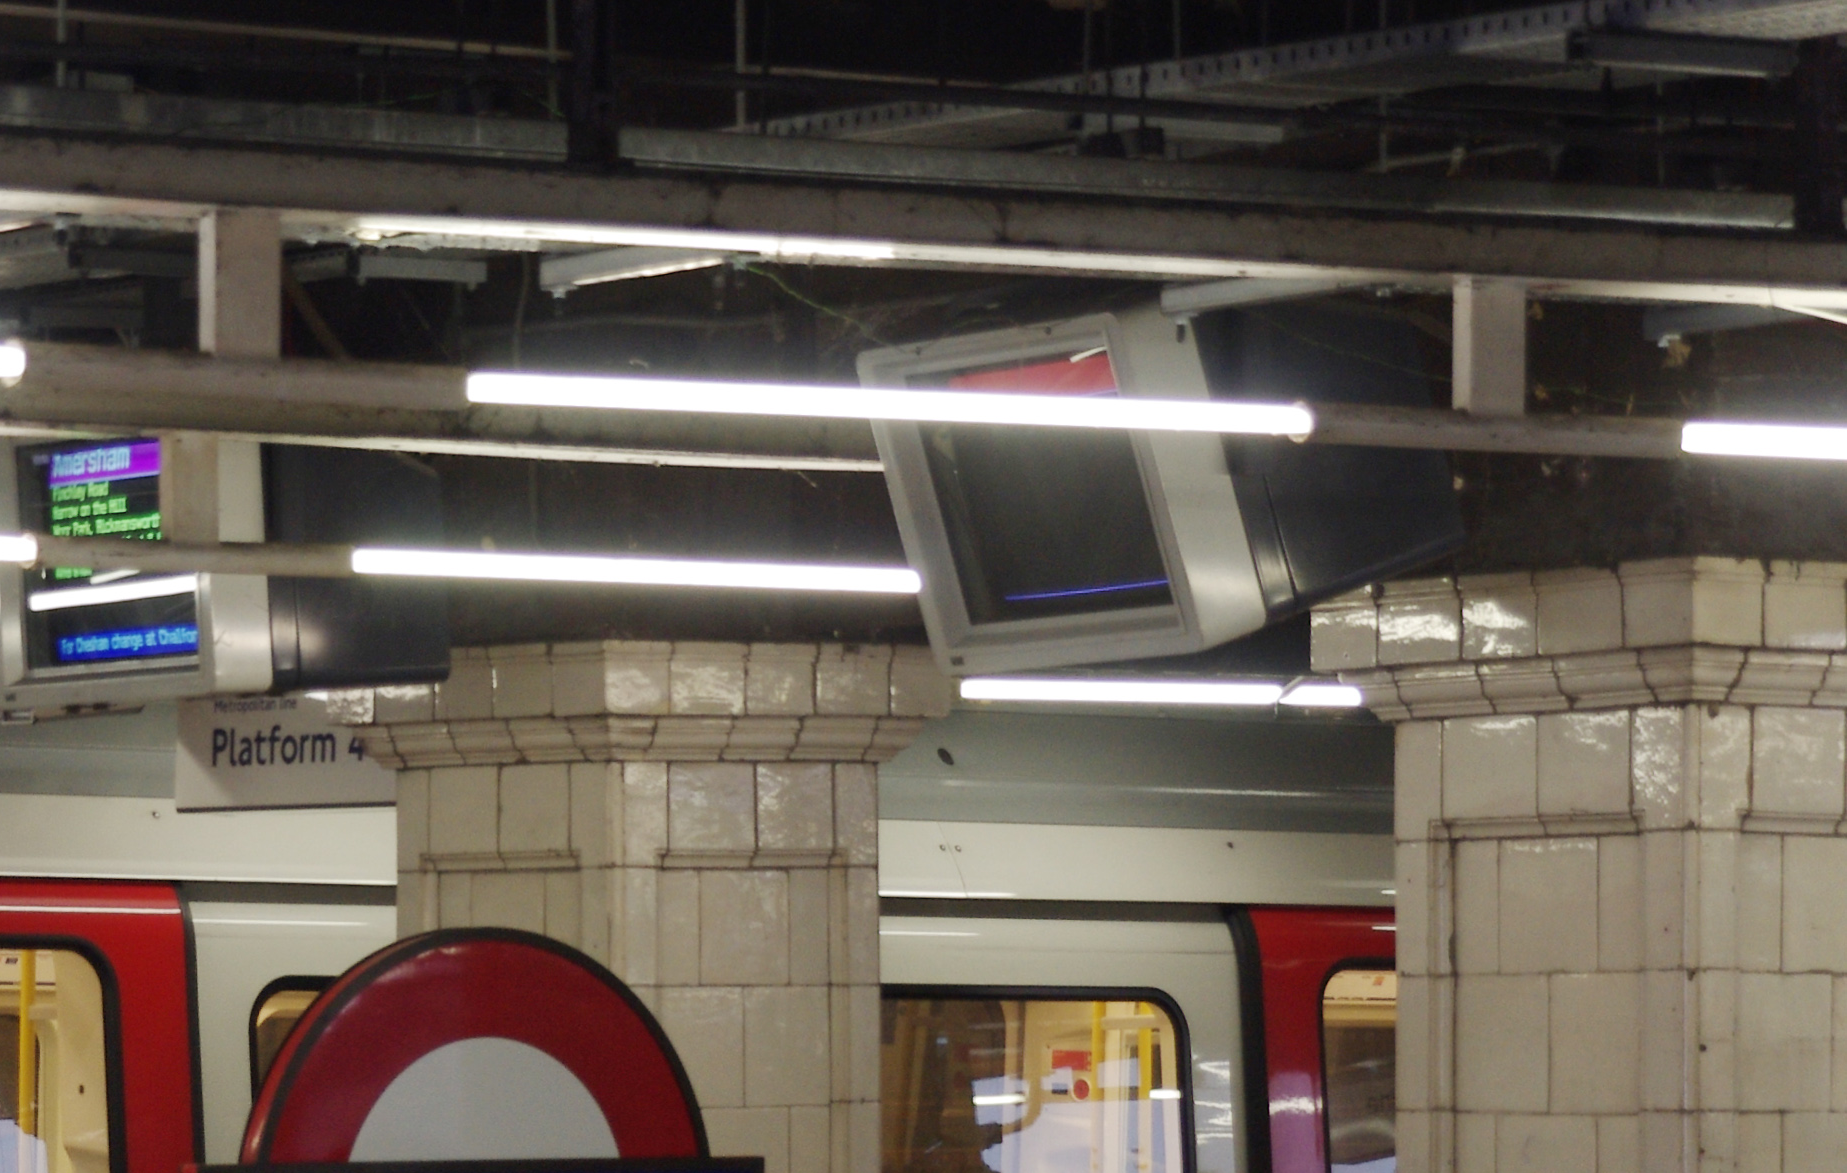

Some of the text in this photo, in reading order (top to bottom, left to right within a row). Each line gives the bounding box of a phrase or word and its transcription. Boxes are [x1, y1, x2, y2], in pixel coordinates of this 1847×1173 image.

[52, 446, 131, 477] Amersham
[92, 501, 107, 515] the
[111, 632, 143, 650] change
[145, 630, 157, 646] at
[214, 698, 277, 714] Metropolitan
[212, 724, 364, 767] Platform 4
